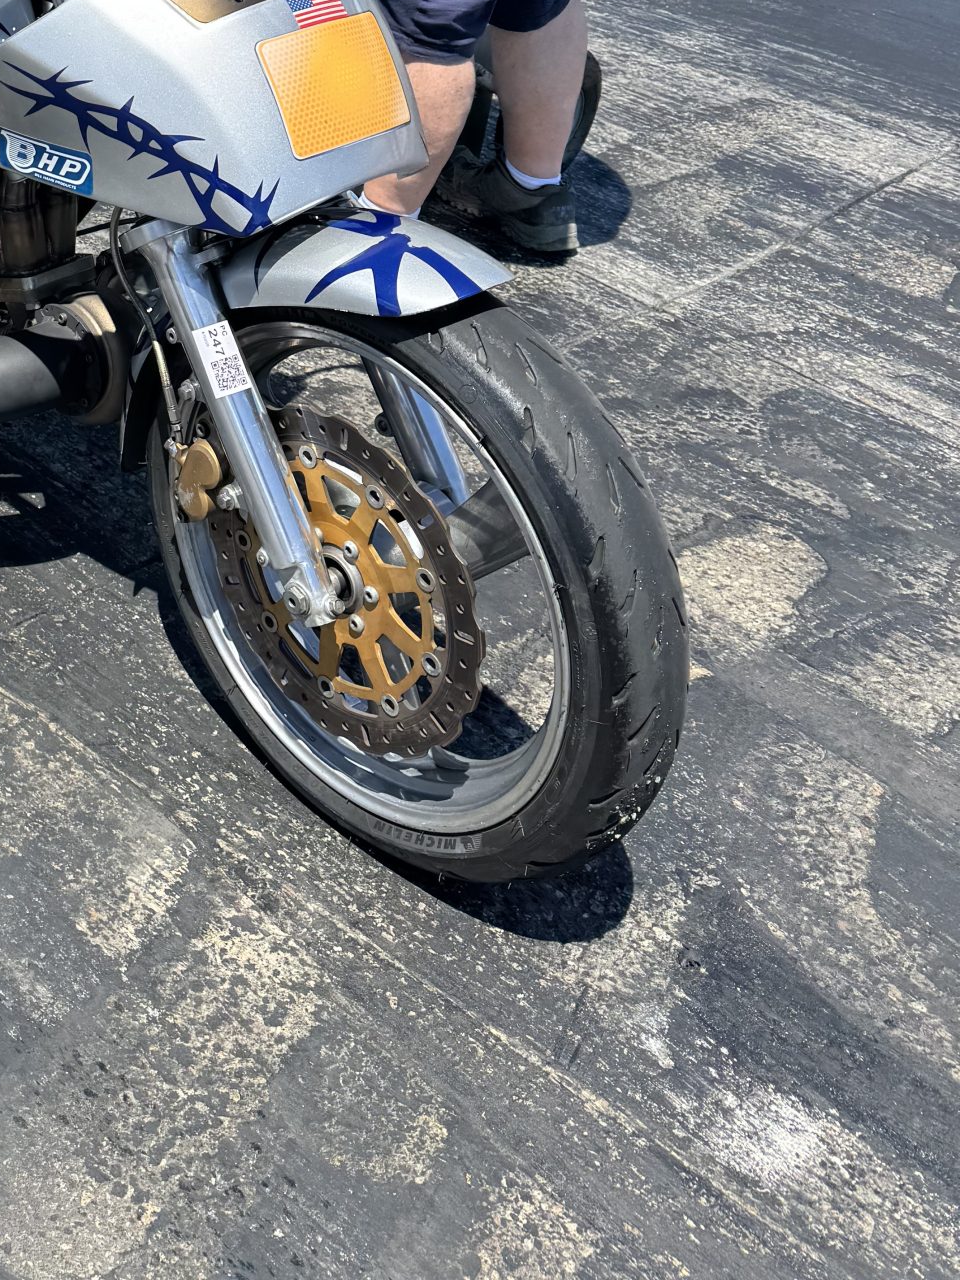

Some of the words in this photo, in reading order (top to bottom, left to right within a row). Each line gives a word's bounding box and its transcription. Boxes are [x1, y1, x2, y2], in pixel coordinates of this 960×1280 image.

[6, 134, 82, 176] BHP
[55, 180, 76, 190] PRODUCTS
[208, 328, 225, 356] 247
[220, 324, 228, 336] PC
[373, 819, 457, 850] MICHELIN
